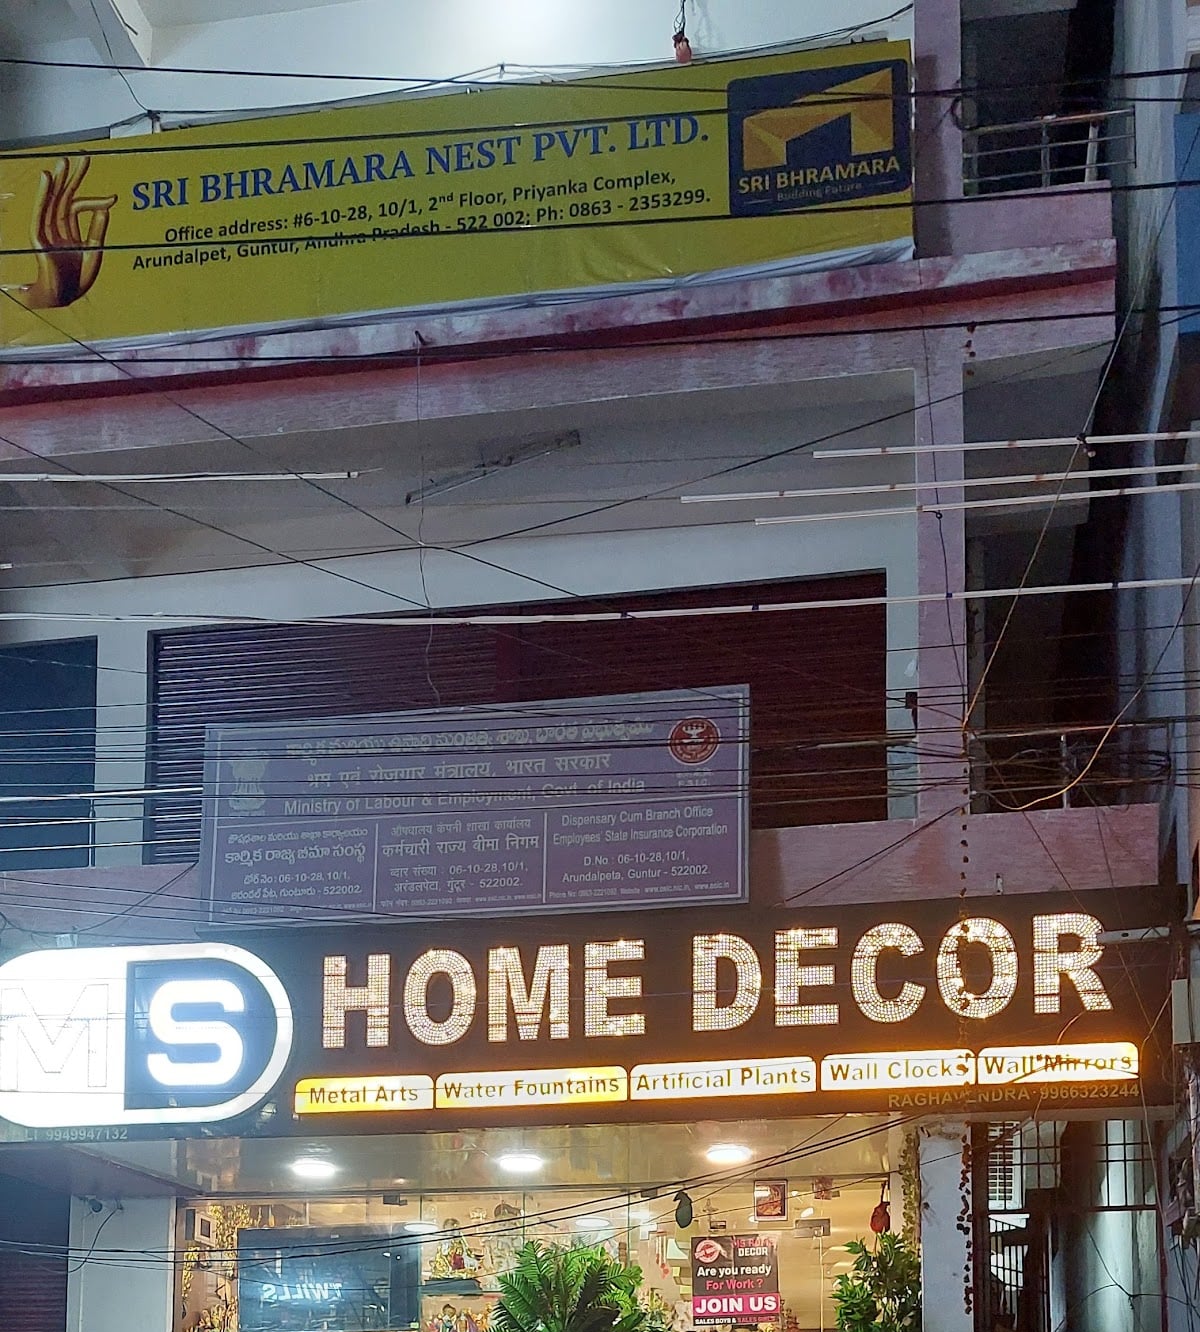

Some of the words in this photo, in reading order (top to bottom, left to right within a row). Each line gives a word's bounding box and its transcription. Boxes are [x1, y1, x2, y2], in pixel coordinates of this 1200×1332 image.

[132, 178, 189, 211] SRI
[200, 150, 415, 203] BHRAMARA
[425, 136, 521, 175] NEST
[533, 125, 616, 162] PVT.
[627, 114, 708, 150] LTD.
[738, 175, 770, 194] SRI
[776, 156, 900, 188] BHRAMARA
[165, 225, 213, 243] Office
[218, 219, 288, 237] address:
[293, 206, 372, 228] #6-10-28,
[379, 198, 423, 218] 10/1,
[459, 190, 507, 208] Floor,
[513, 179, 587, 202] Priyanka
[594, 170, 676, 191] Complex,
[132, 246, 232, 270] Arundalpet,
[237, 240, 299, 258] Guntur,
[493, 210, 530, 227] 002;
[536, 207, 564, 223] Ph:
[569, 200, 612, 217] 0863
[629, 189, 711, 211] 2353299.
[506, 757, 546, 775] भारत
[554, 753, 611, 771] सरकार
[284, 798, 341, 816] Ministry
[346, 797, 361, 811] of
[365, 795, 417, 809] Labour
[587, 779, 604, 793] of
[608, 778, 645, 792] India
[562, 813, 616, 827] Dispensary
[620, 811, 643, 823] Cum
[646, 808, 681, 822] Branch
[684, 805, 713, 818] Office
[605, 829, 628, 842] State
[631, 825, 674, 840] Insurance
[676, 822, 728, 839] Corporation
[382, 837, 430, 857] कर्मचारी
[437, 841, 466, 854] राज्य
[505, 833, 540, 850] निगम
[627, 867, 661, 879] Guntur
[322, 937, 645, 1050] HOME
[691, 912, 1114, 1033] DECOR
[829, 1061, 878, 1082] Wall
[887, 1057, 969, 1079] Clocks
[984, 1056, 1034, 1075] Wall
[1044, 1054, 1132, 1073] Mirrors
[443, 1080, 504, 1100] Water
[514, 1073, 620, 1097] Fountains
[636, 1069, 732, 1091] Artificial
[741, 1064, 811, 1087] Plants
[309, 1084, 367, 1104] Metal
[374, 1083, 418, 1104] Arts
[1041, 1082, 1140, 1100] 9966323244
[46, 1127, 128, 1141] 9949947132
[738, 1246, 768, 1257] DECOR
[697, 1266, 717, 1277] Are
[719, 1267, 739, 1278] you
[740, 1264, 772, 1276] ready
[706, 1280, 724, 1291] For
[726, 1279, 754, 1290] Work
[757, 1278, 764, 1288] ?
[694, 1297, 743, 1314] JOIN
[749, 1296, 777, 1312] US
